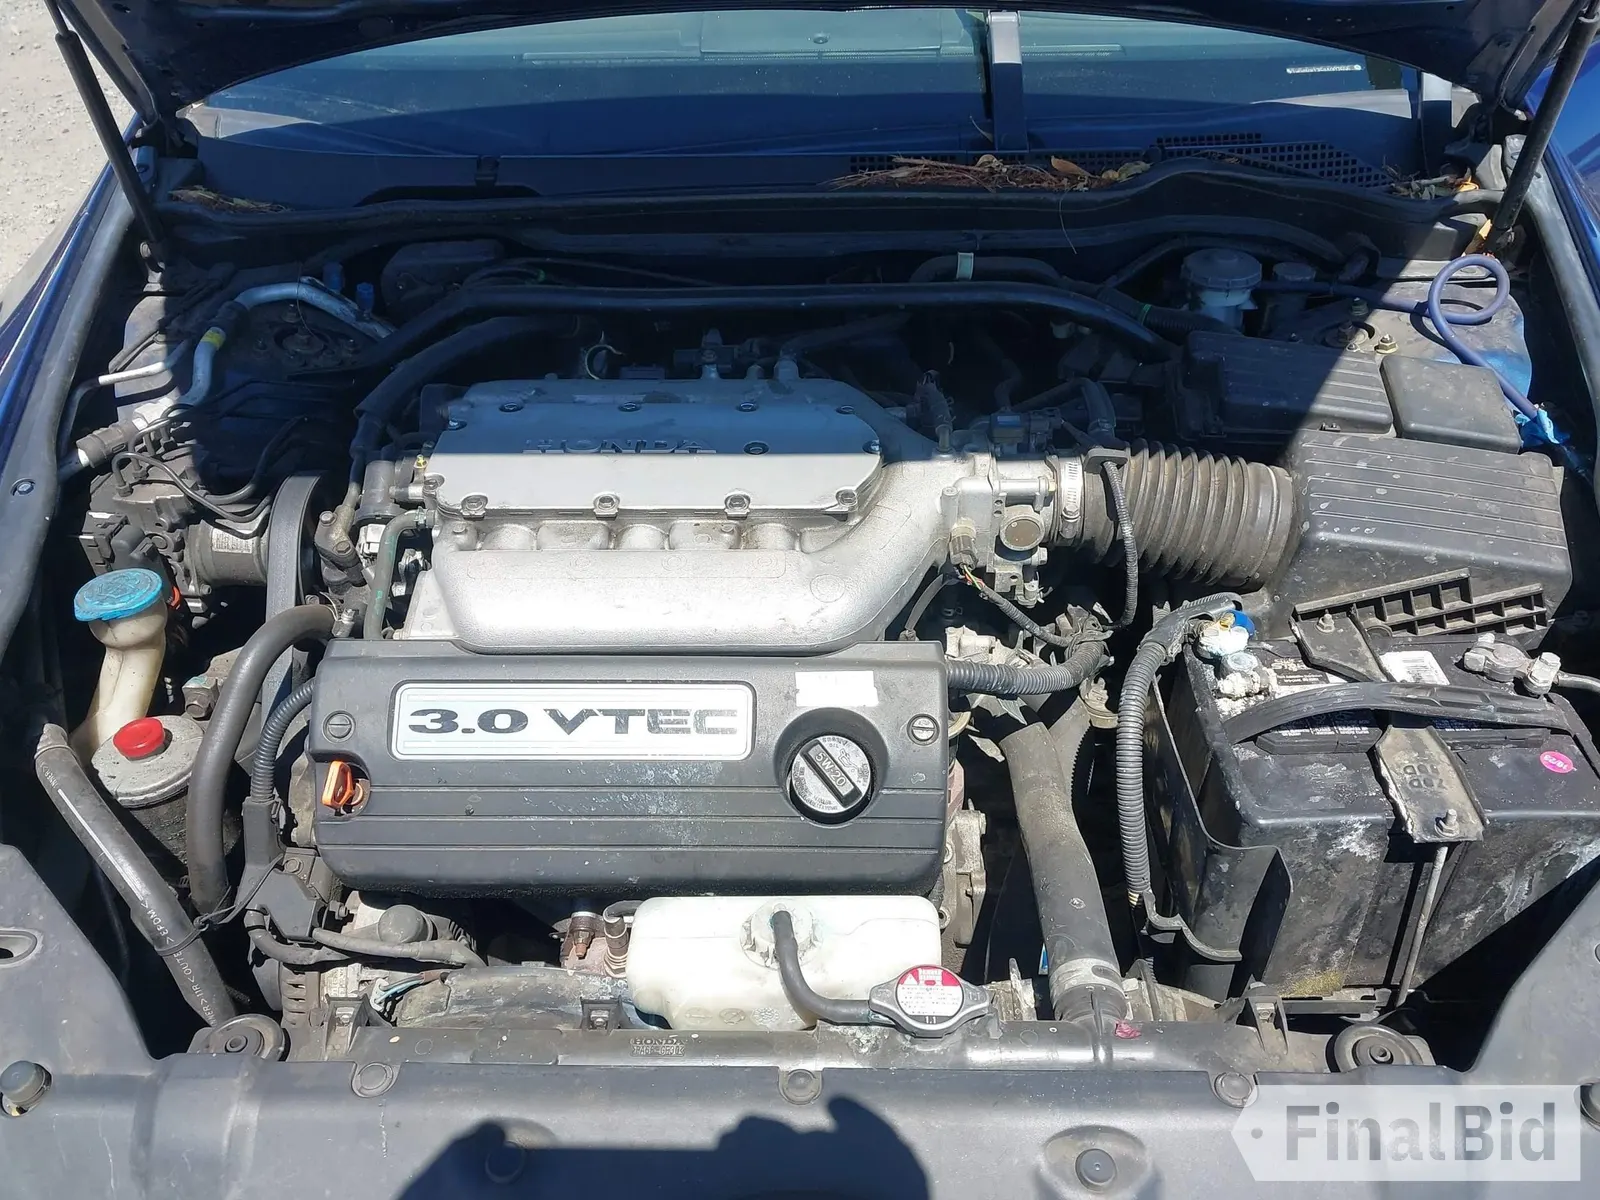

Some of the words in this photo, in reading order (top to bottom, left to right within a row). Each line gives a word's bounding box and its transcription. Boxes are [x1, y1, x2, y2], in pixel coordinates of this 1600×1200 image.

[521, 439, 717, 453] HONDA
[408, 708, 529, 735] 3.0
[543, 708, 738, 736] VTEC
[815, 752, 847, 787] 5W-20
[924, 1015, 937, 1025] 1.1
[631, 1037, 686, 1046] HONDA
